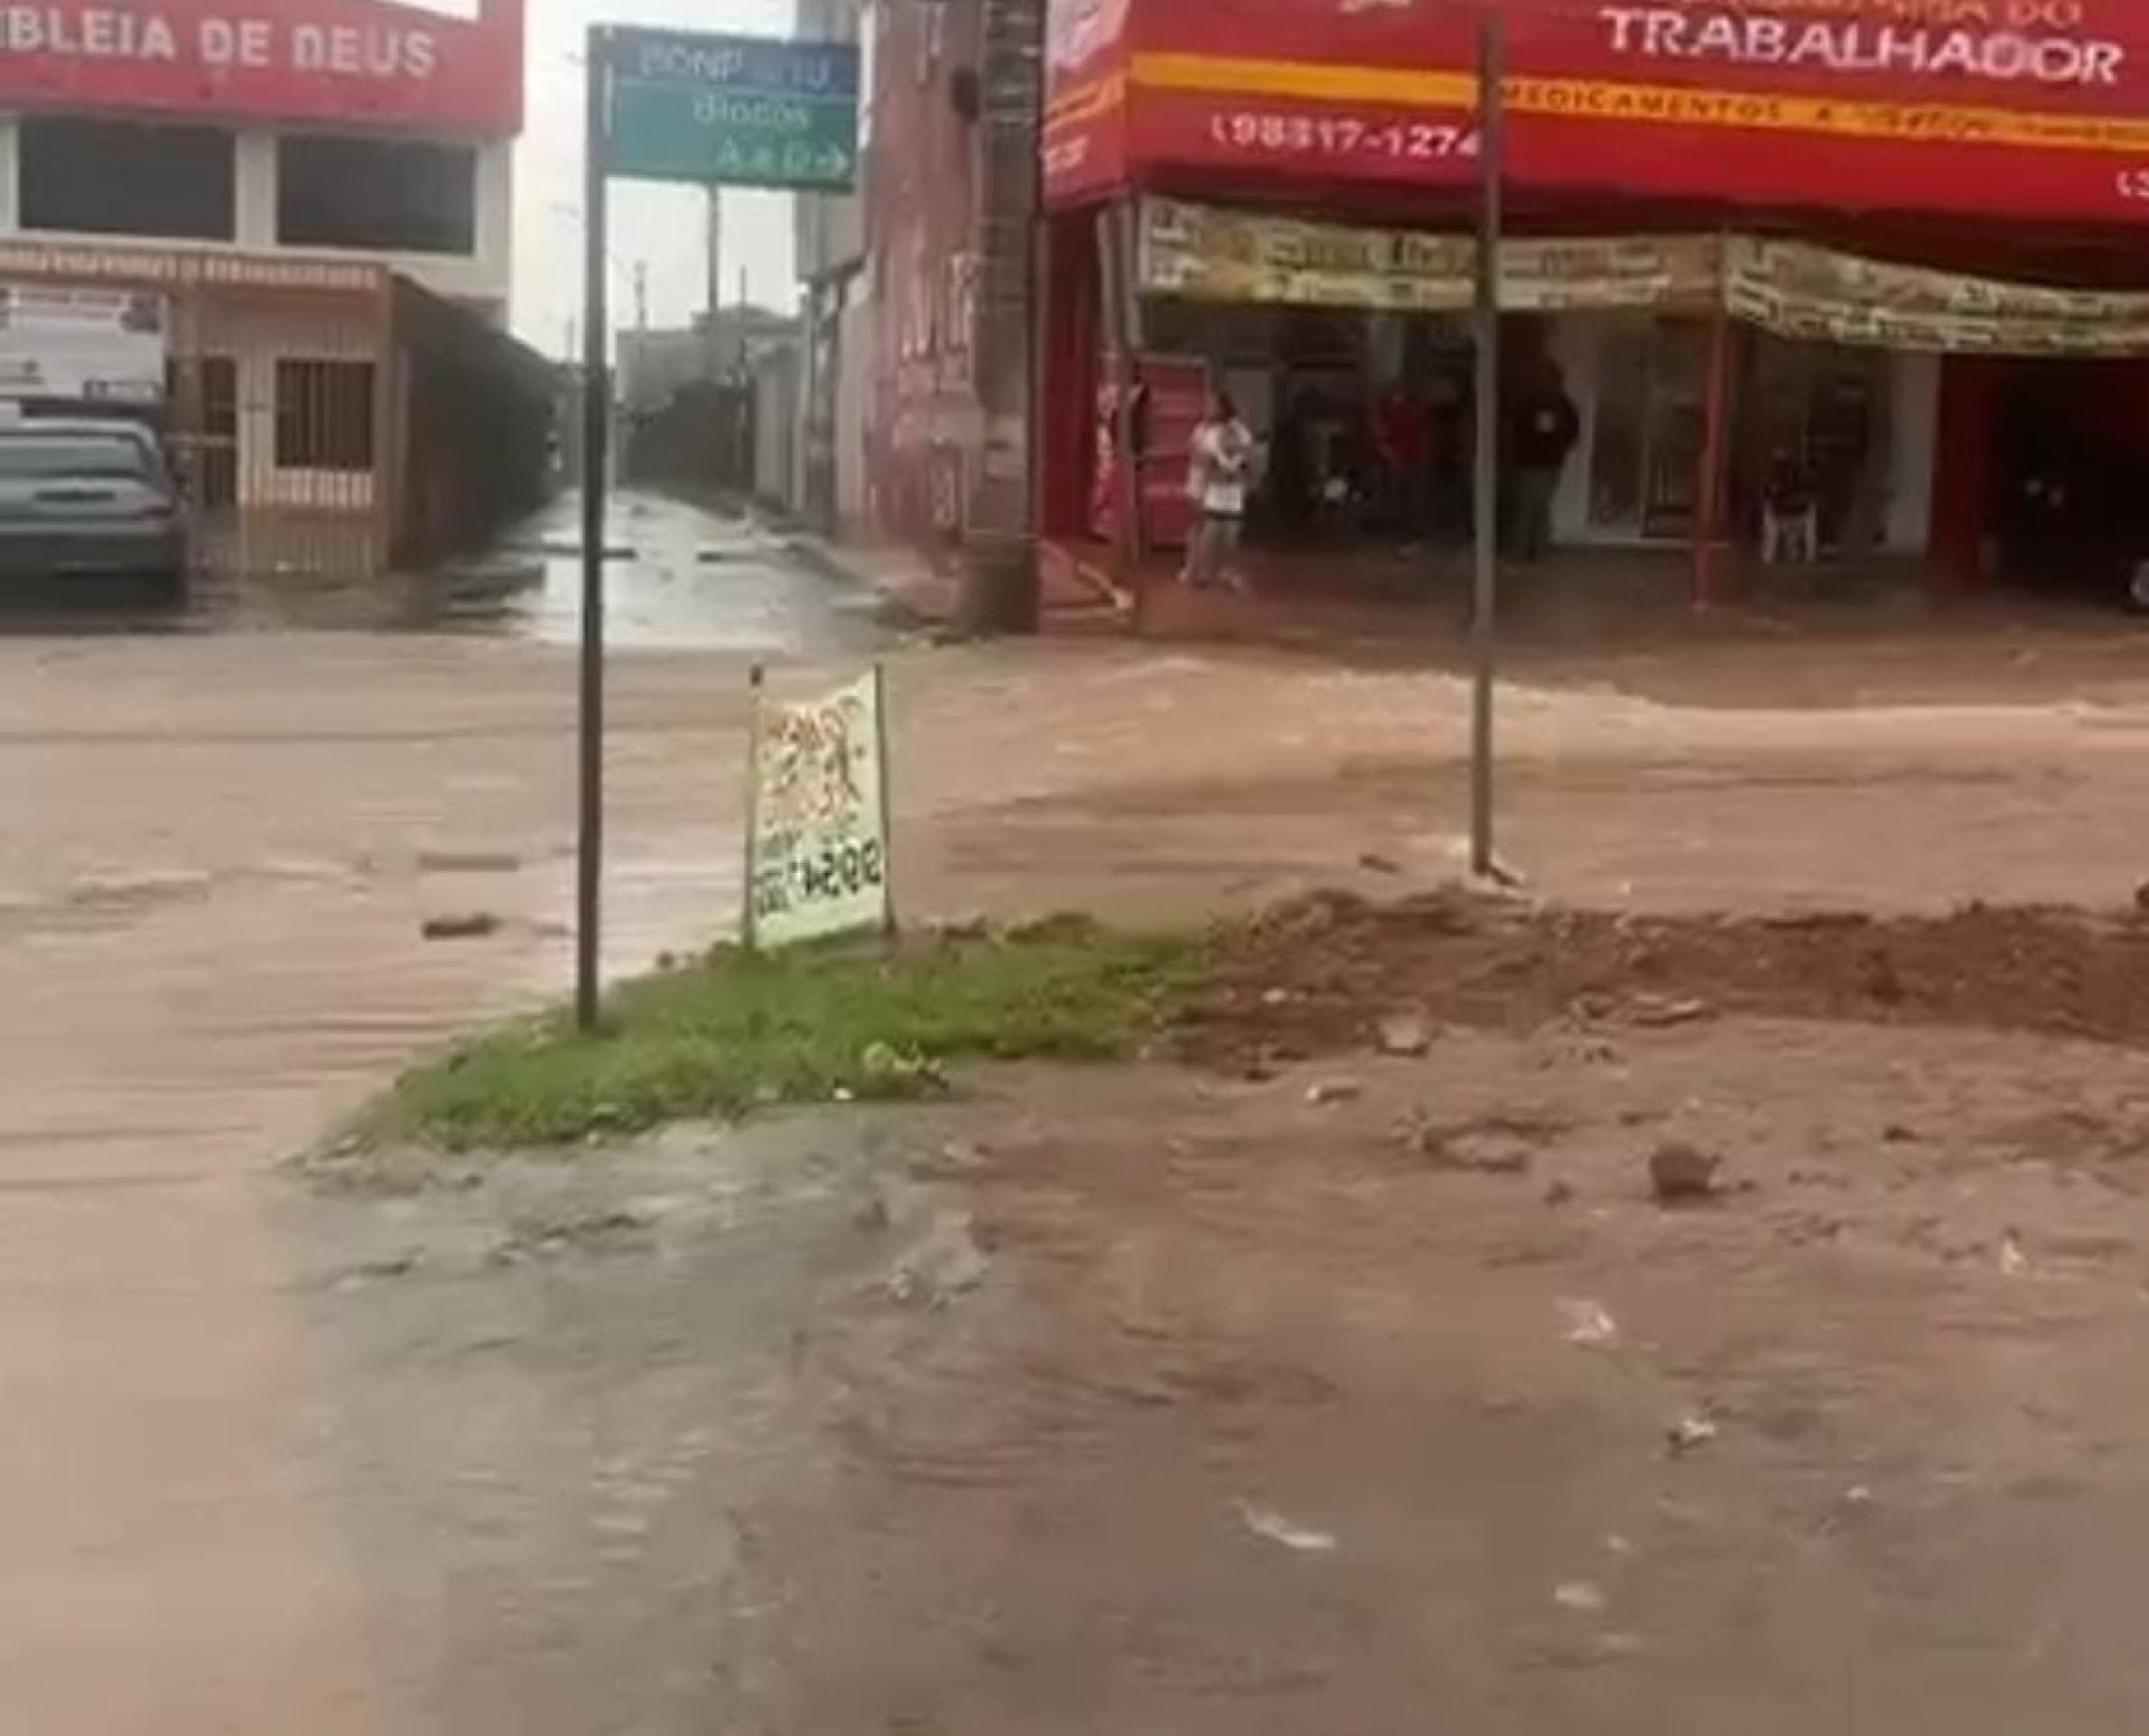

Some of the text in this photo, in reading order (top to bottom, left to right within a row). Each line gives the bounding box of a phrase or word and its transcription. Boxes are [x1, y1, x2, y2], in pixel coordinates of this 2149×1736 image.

[0, 7, 175, 59] BLEIA
[200, 20, 270, 67] DE
[1601, 8, 2124, 84] TRABALHADOR
